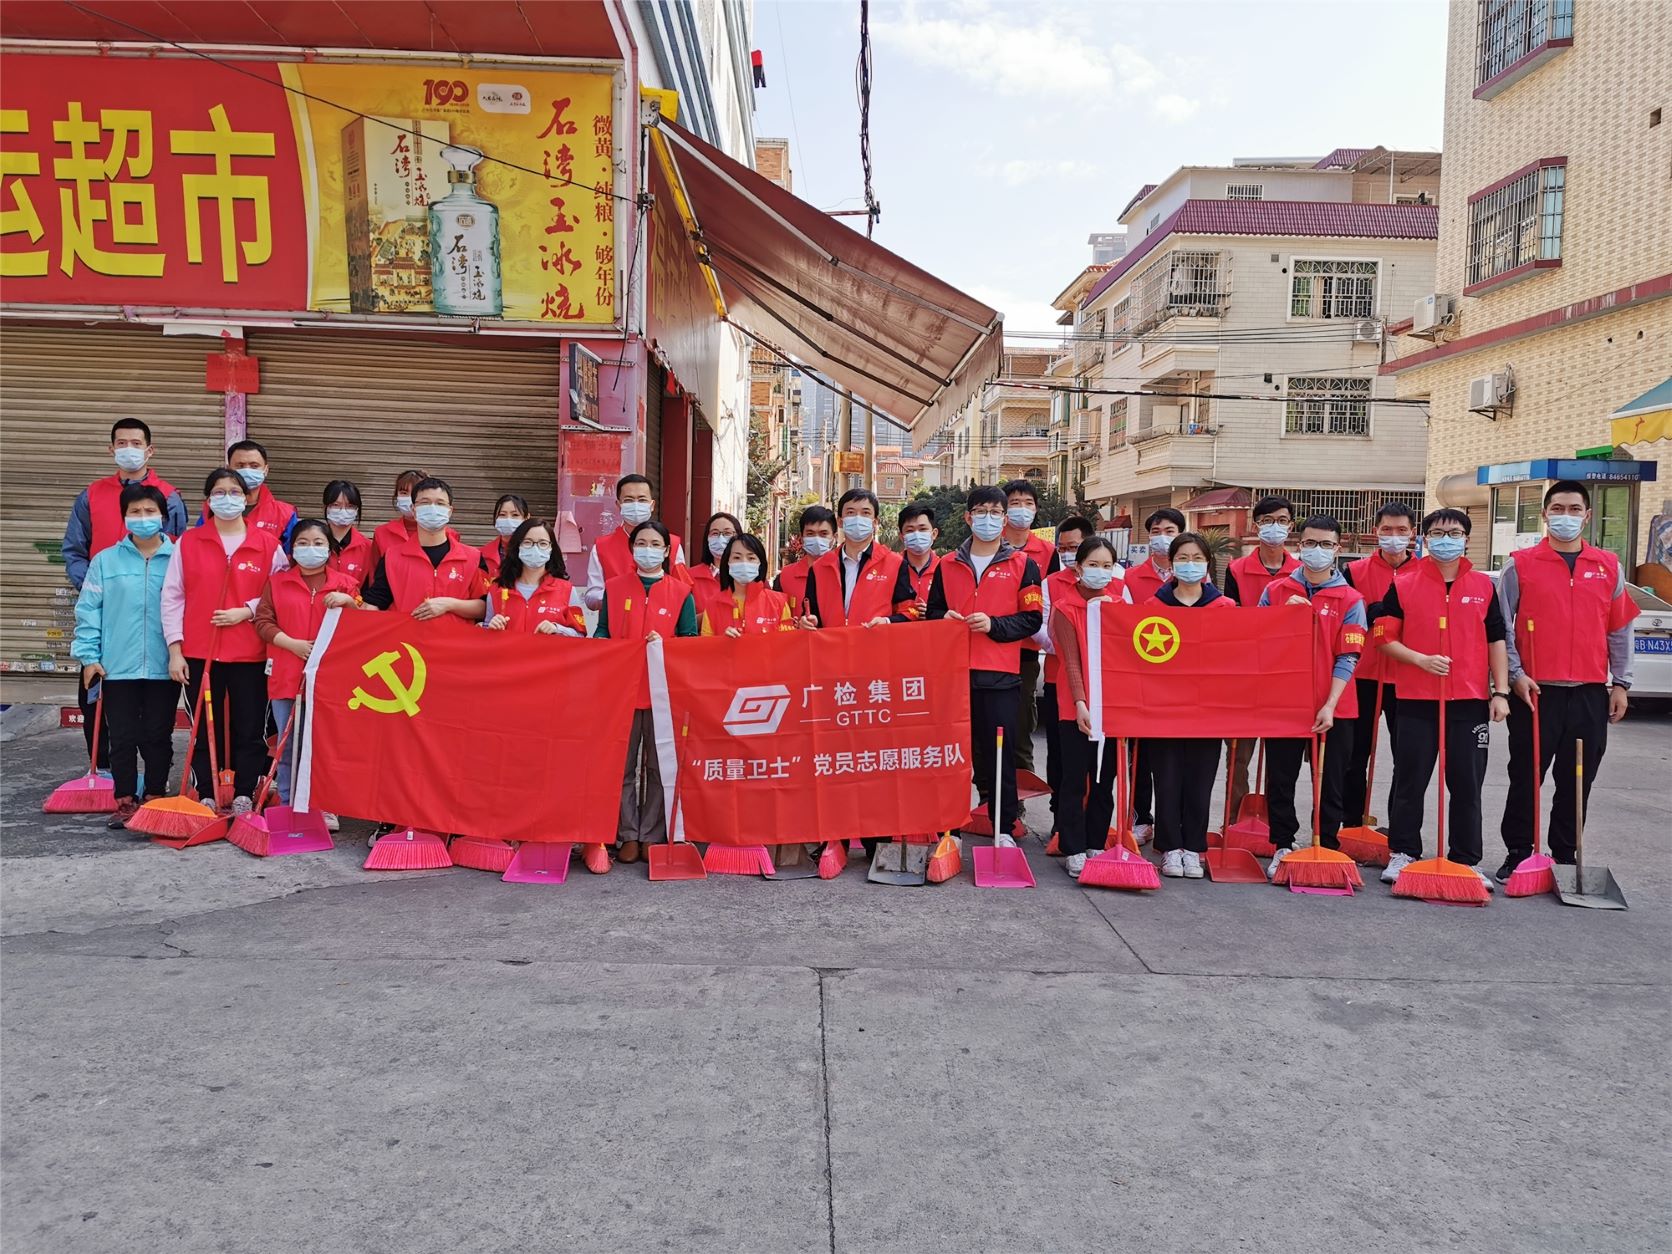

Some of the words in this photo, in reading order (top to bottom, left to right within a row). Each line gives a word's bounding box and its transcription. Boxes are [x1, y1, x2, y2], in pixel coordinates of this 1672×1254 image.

[536, 96, 585, 320] 石湾玉冰烧
[801, 676, 926, 708] 广检集团
[836, 708, 891, 726] GTTC
[814, 742, 966, 777] 党员志愿服务队
